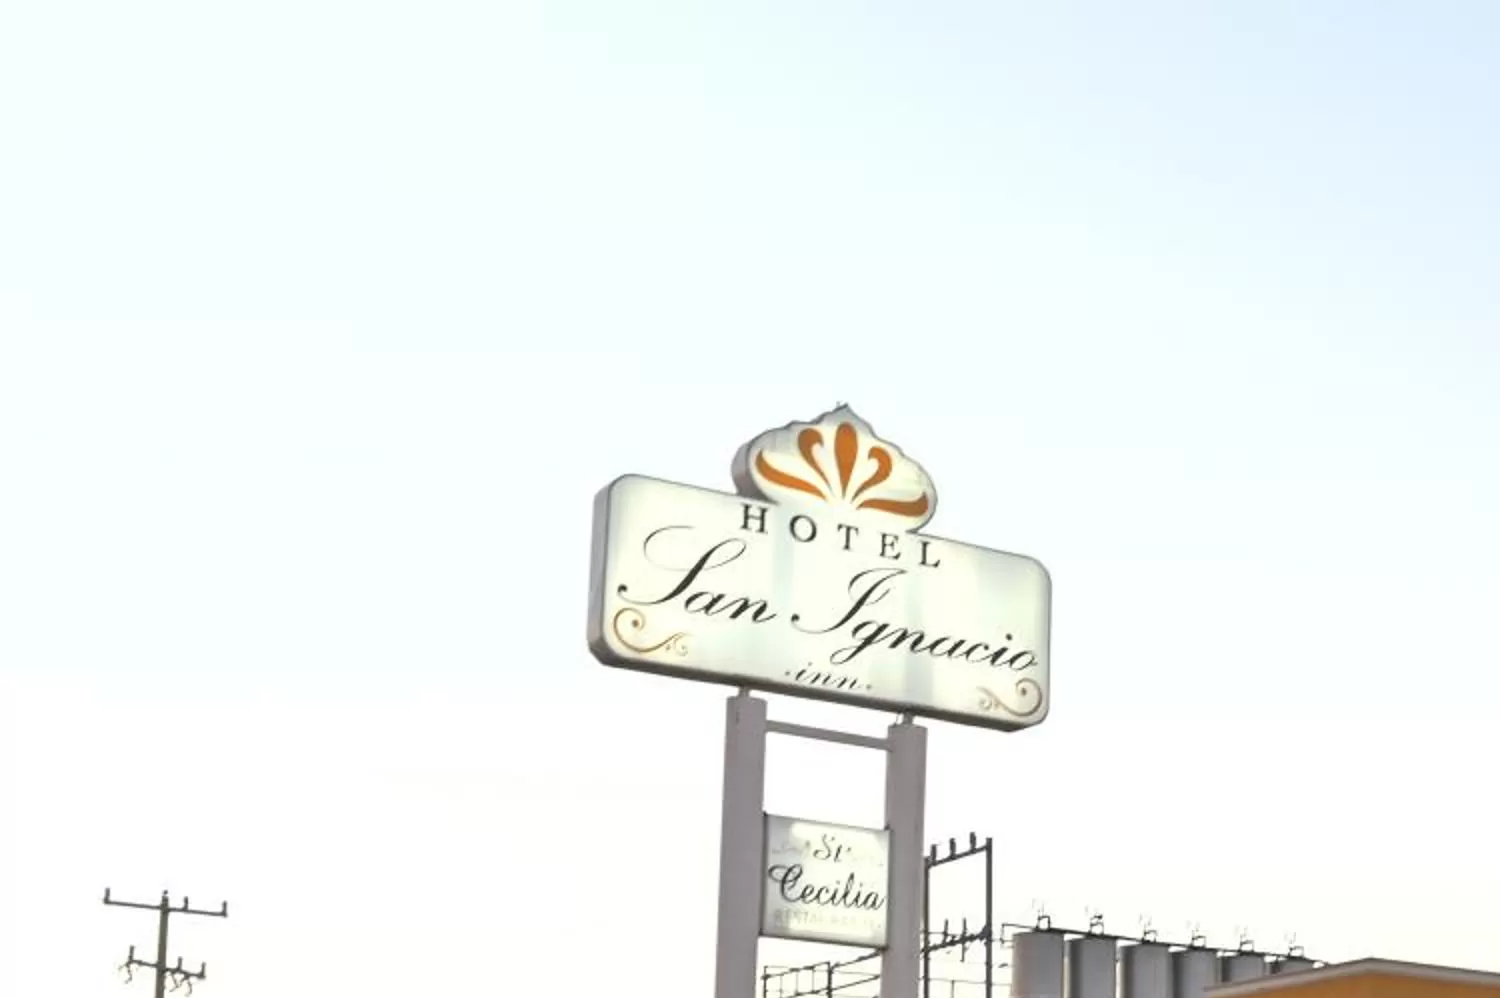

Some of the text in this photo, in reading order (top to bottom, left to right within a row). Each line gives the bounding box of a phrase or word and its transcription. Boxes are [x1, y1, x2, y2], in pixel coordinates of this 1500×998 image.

[740, 503, 941, 568] HOTEL
[616, 525, 1038, 671] San Ignacio
[767, 864, 887, 911] Cecilia
